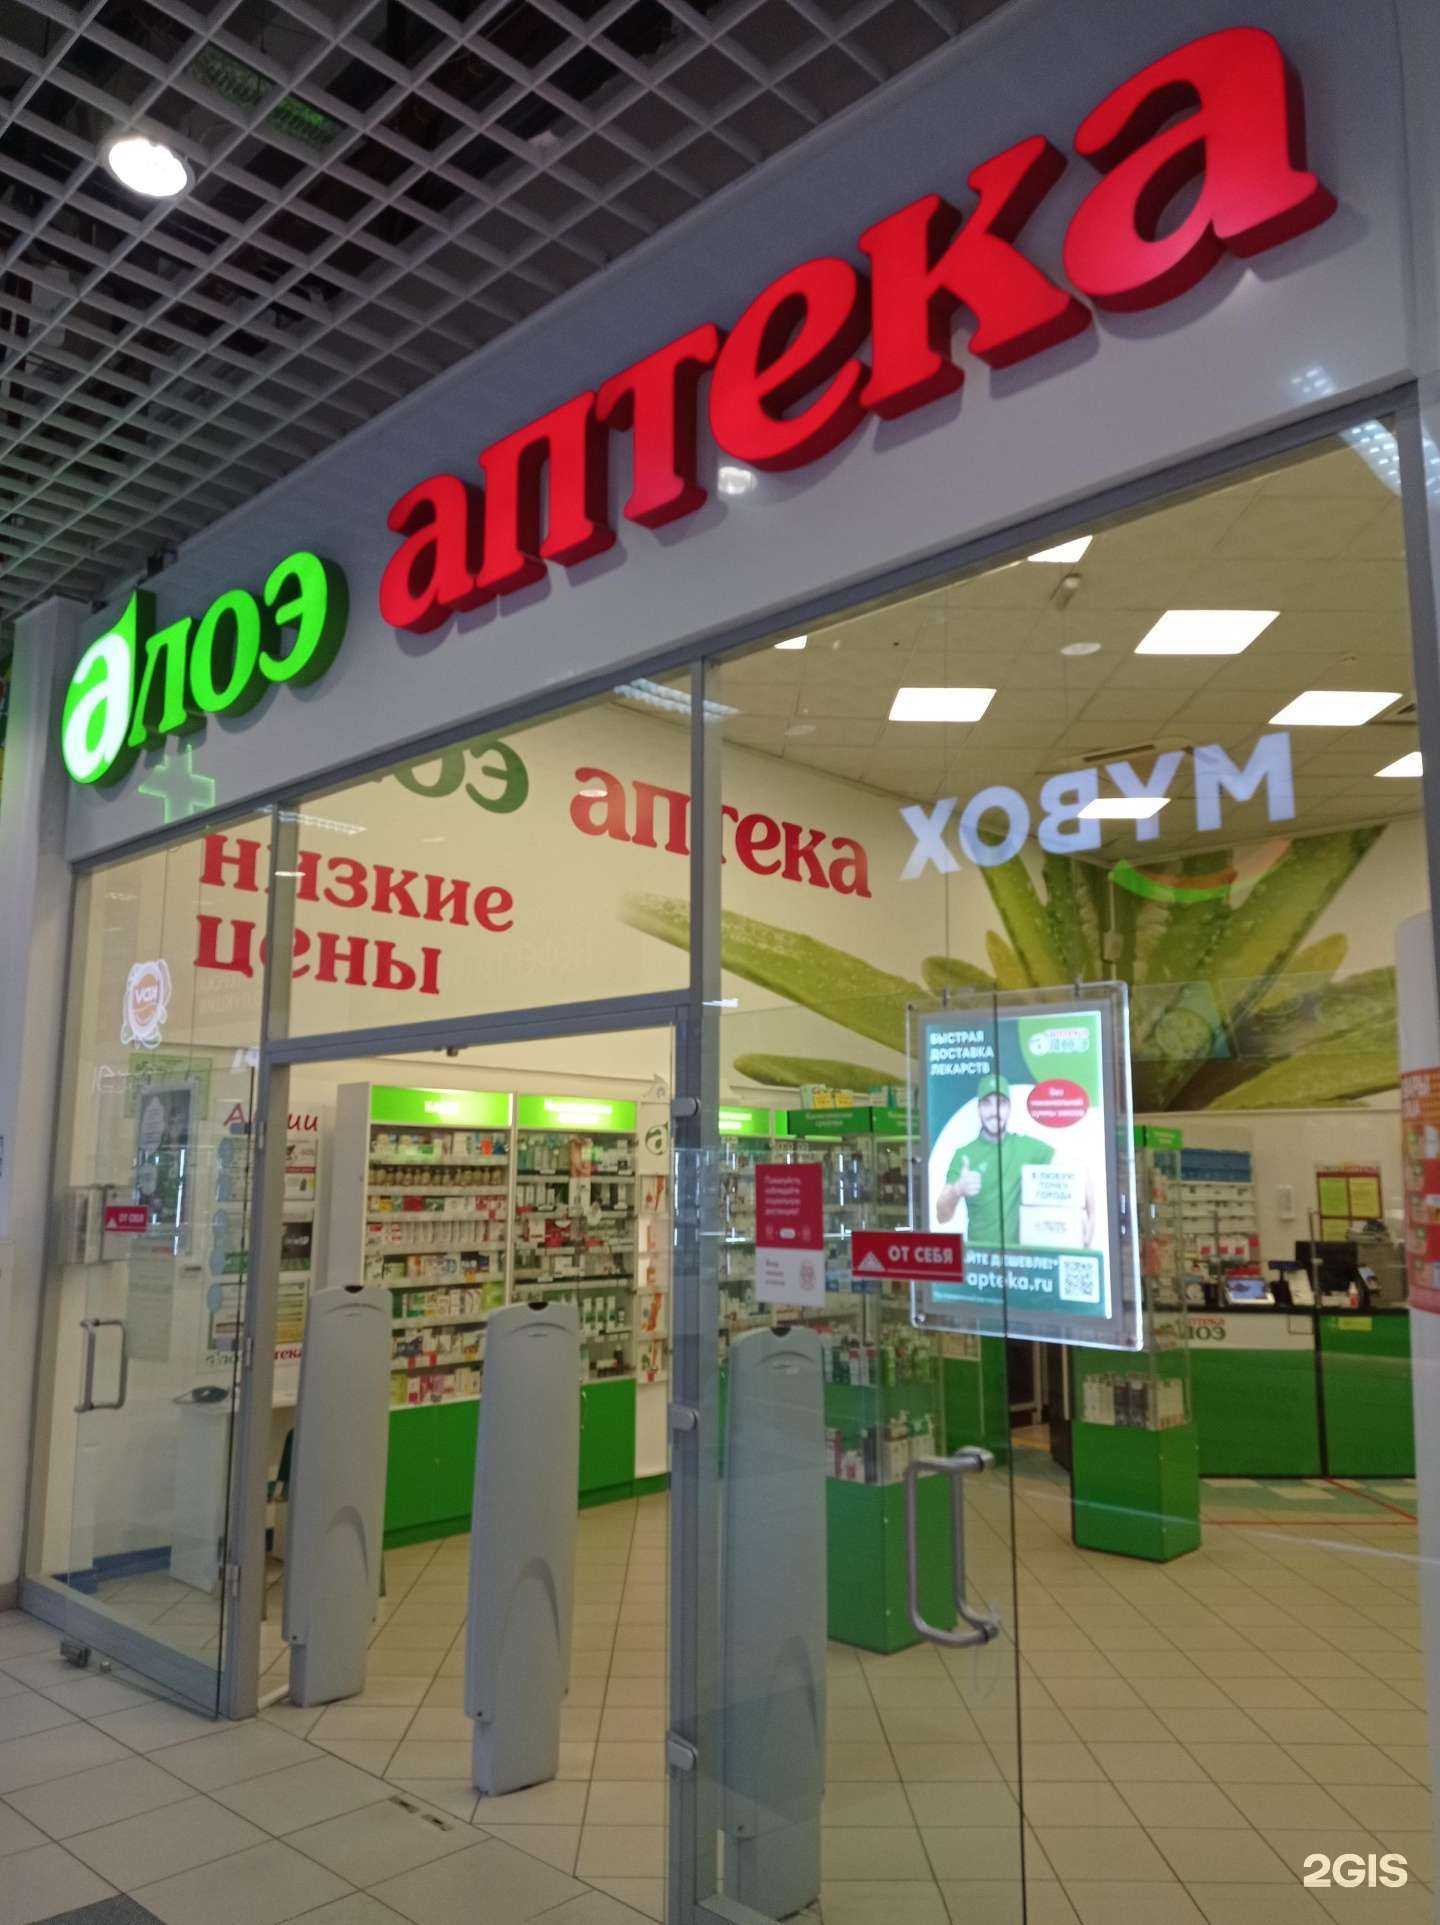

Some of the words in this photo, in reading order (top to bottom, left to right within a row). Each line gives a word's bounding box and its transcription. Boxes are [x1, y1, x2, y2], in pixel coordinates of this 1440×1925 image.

[379, 25, 1336, 633] аптека
[930, 1046, 995, 1061] ДОСТАВКА
[223, 1103, 318, 1131] Аии
[888, 1246, 909, 1262] ОТ
[915, 1246, 954, 1264] СЕБЯ
